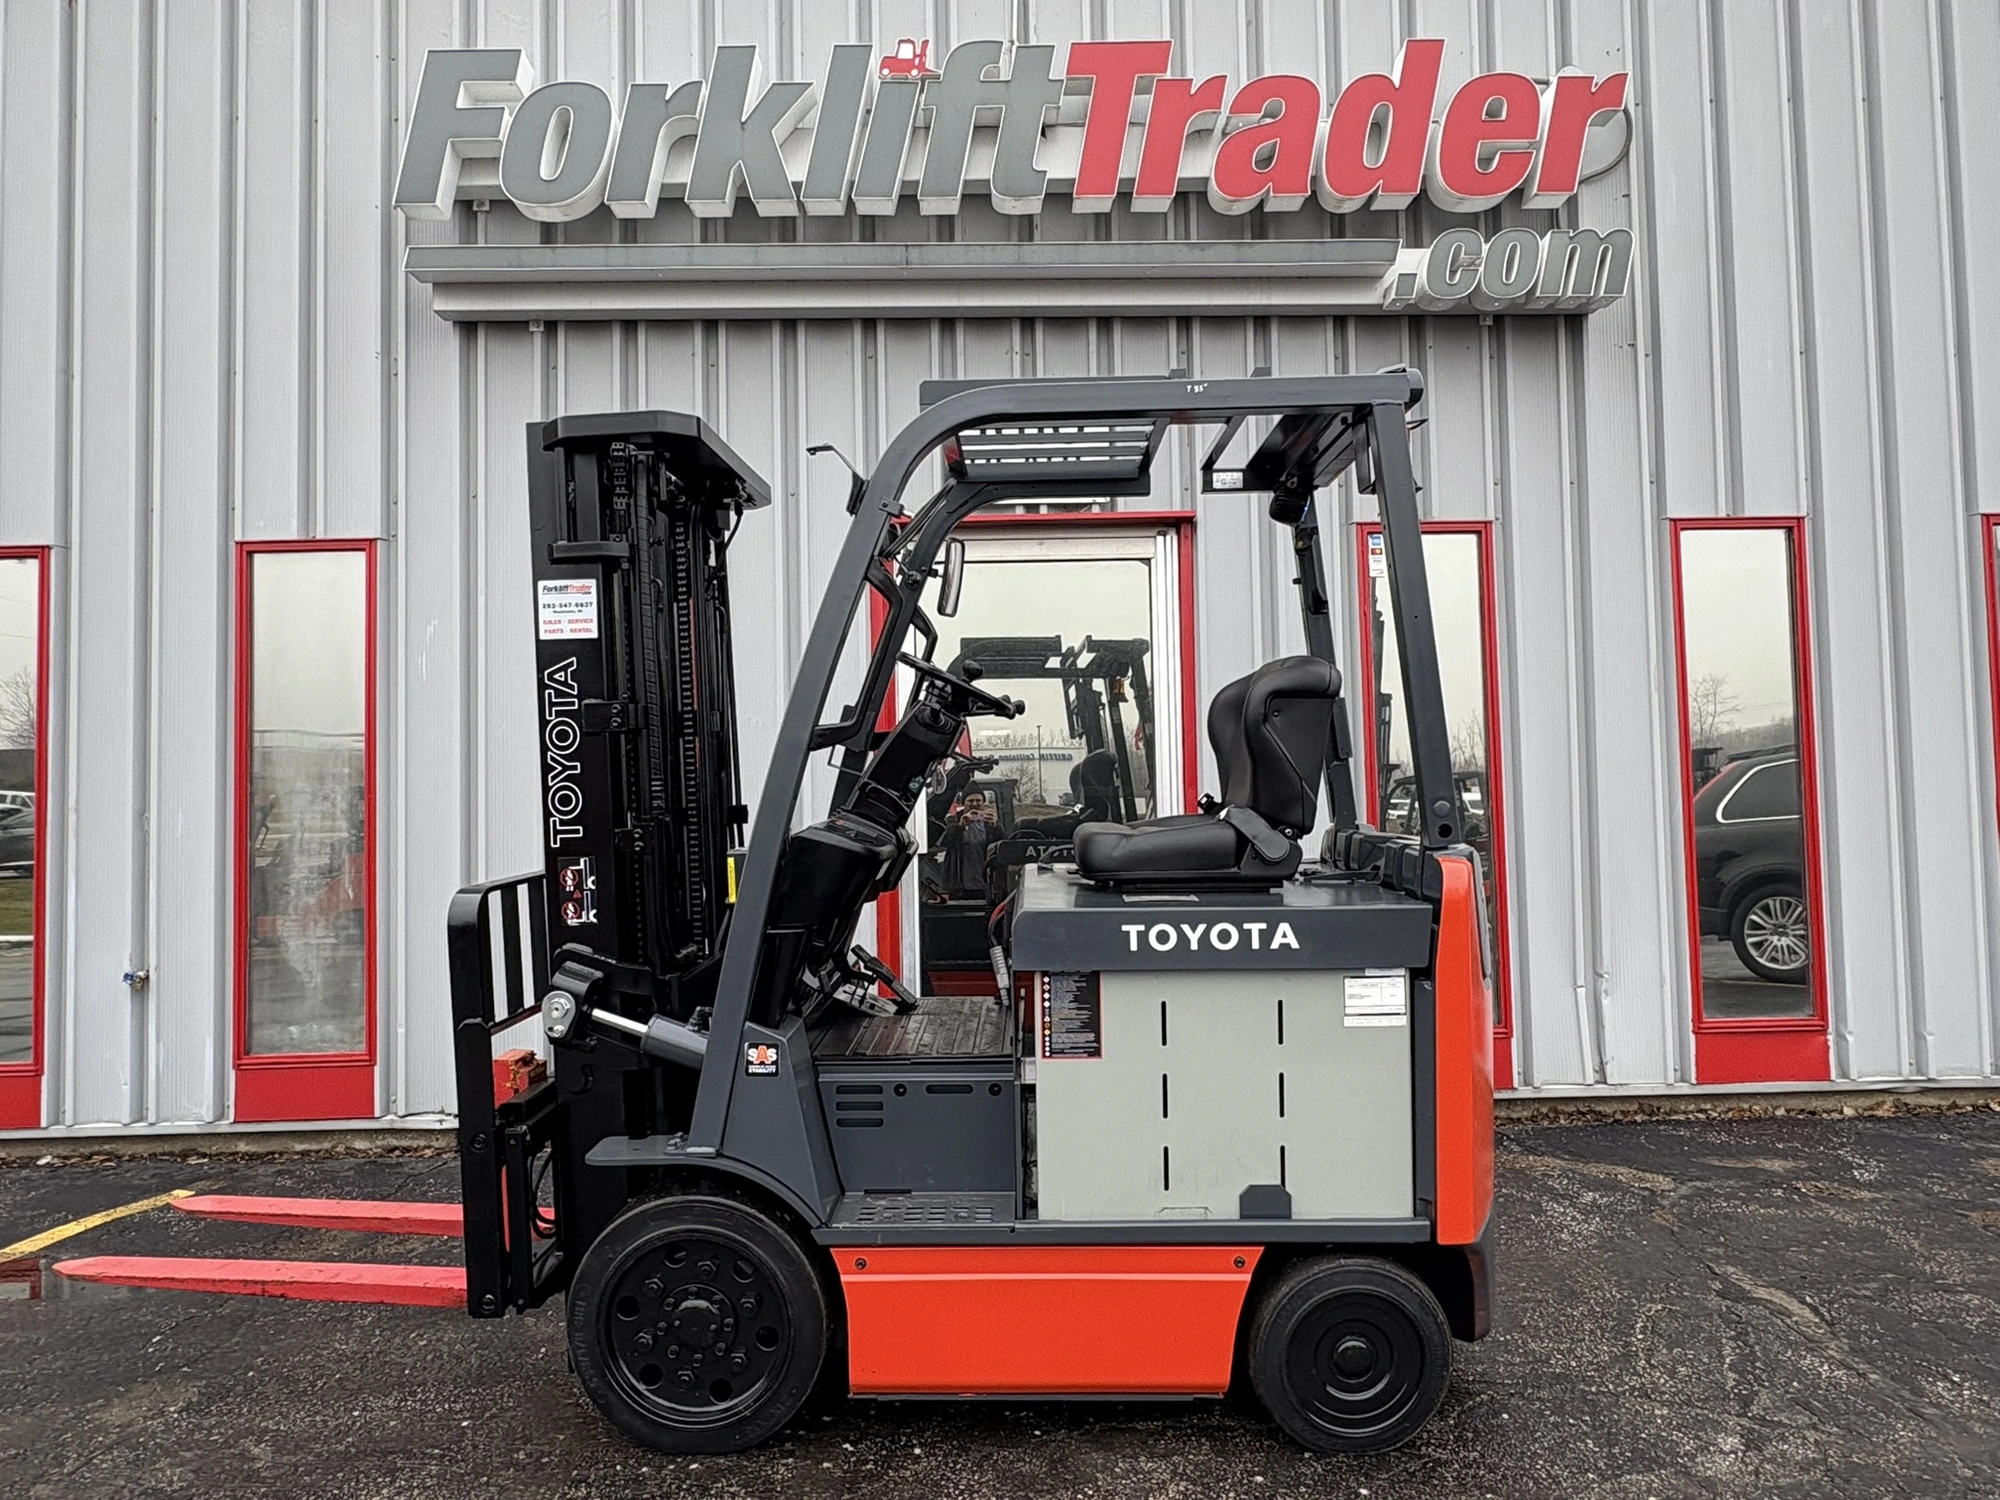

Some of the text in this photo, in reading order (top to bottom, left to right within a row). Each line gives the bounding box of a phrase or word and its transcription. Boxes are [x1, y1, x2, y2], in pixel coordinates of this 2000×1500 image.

[394, 38, 1630, 208] ForkliftTrader
[1387, 228, 1635, 302] .com
[545, 657, 583, 848] TOYOTA
[1121, 922, 1300, 951] TOYOTA
[747, 1044, 778, 1065] SAS
